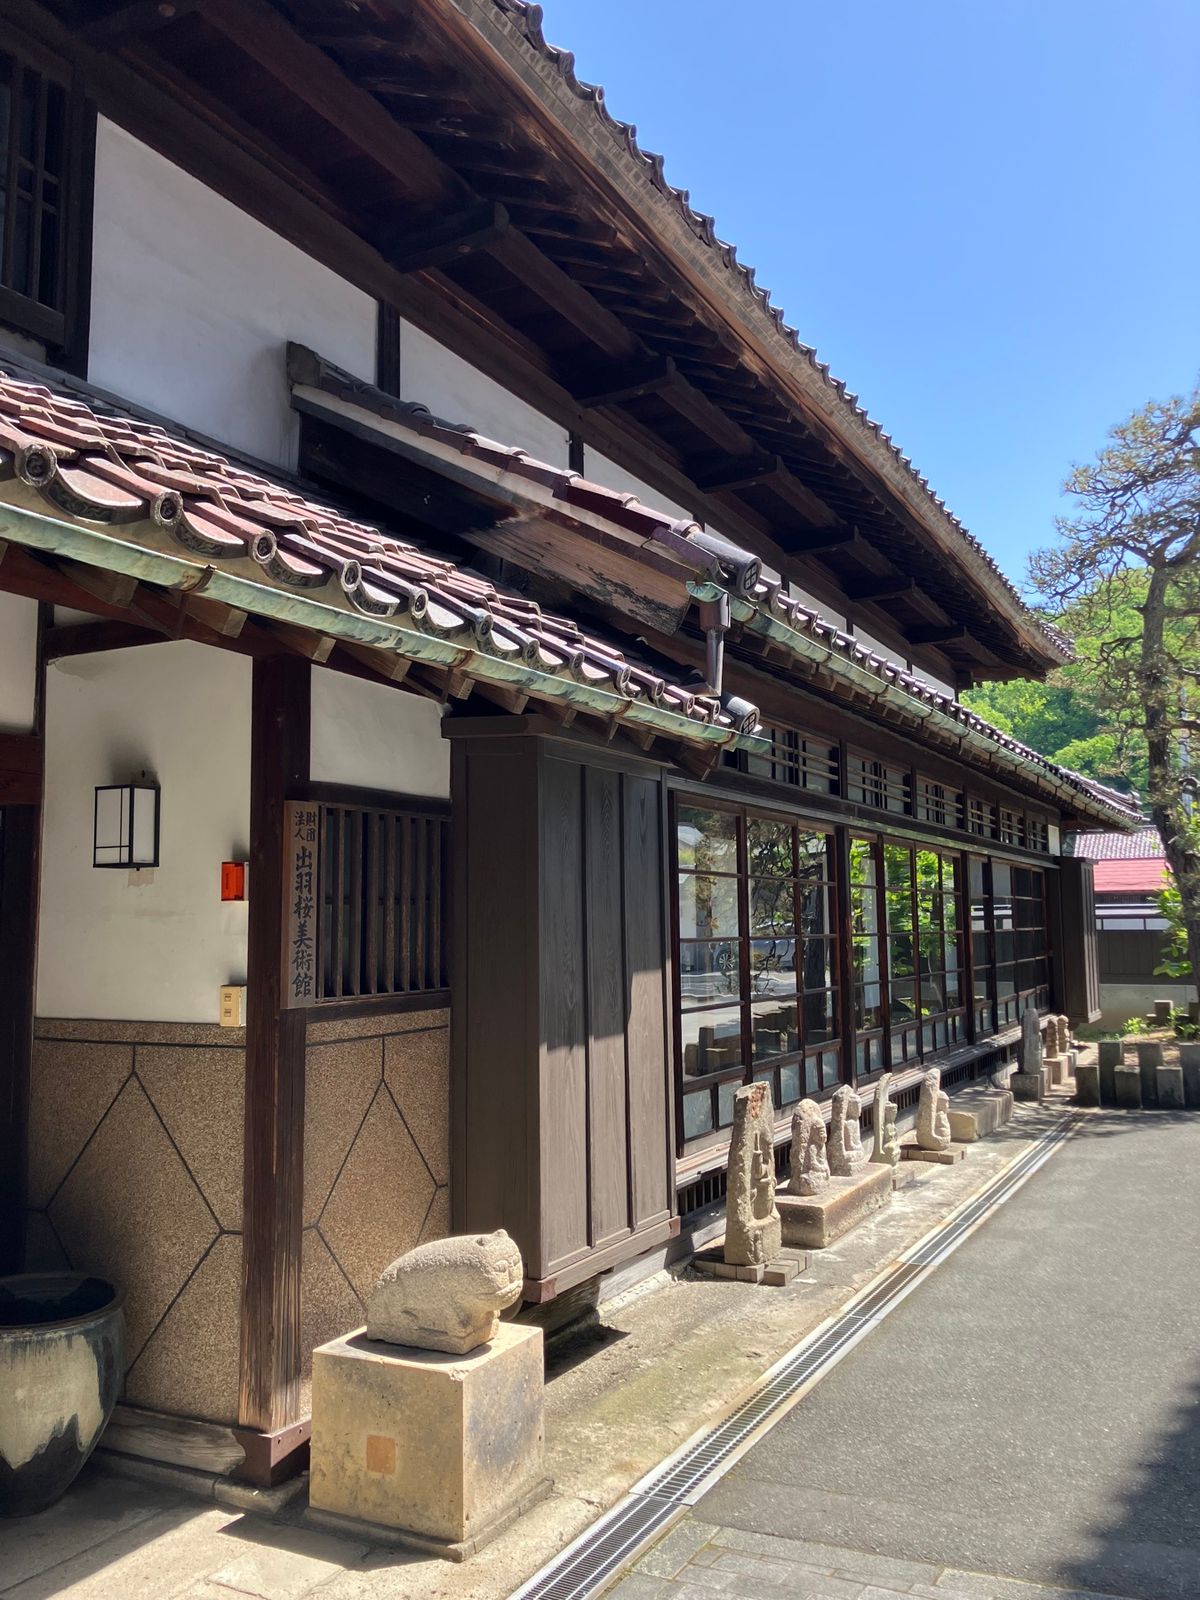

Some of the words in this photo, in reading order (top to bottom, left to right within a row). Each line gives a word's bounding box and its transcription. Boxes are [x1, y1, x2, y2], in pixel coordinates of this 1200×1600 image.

[294, 811, 305, 841] 法人
[291, 846, 314, 998] 出羽桜美術館
